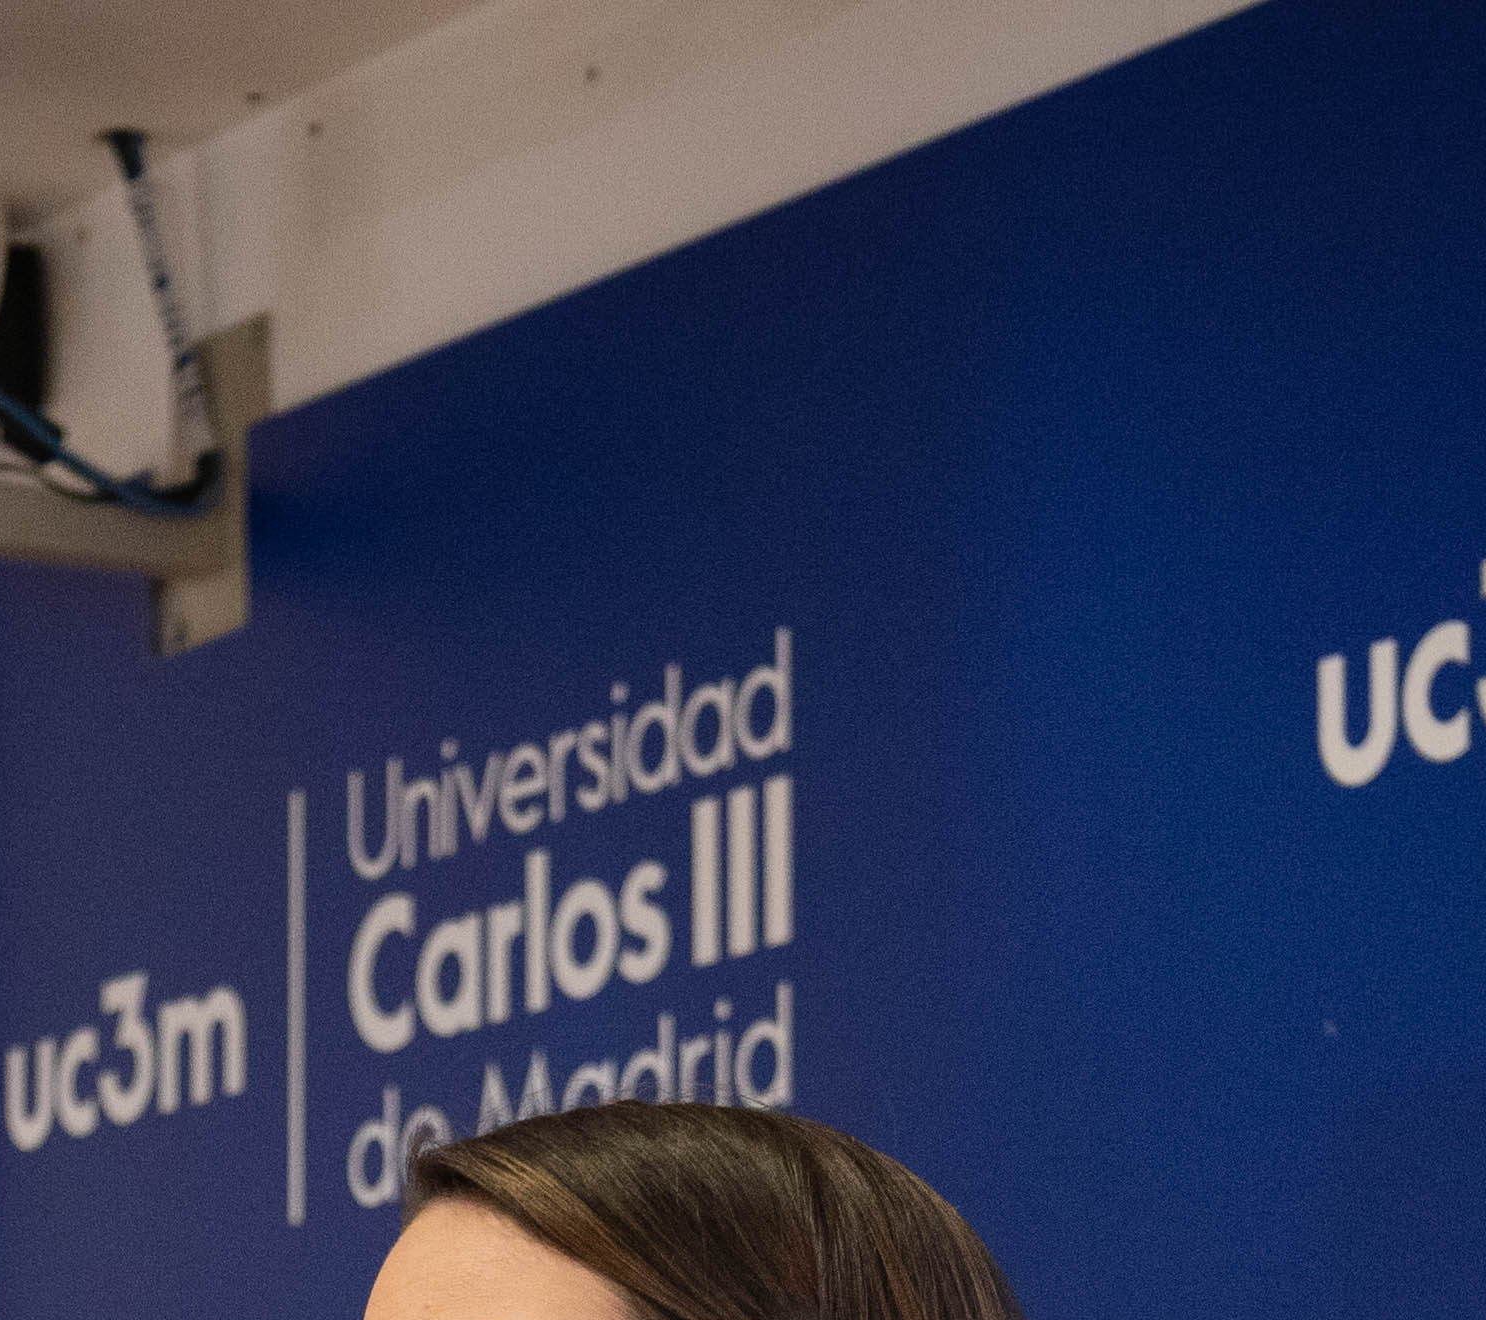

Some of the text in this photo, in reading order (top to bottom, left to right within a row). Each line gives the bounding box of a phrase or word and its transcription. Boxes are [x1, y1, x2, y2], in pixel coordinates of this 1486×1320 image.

[346, 626, 794, 880] Universidad
[347, 774, 795, 1054] Carlos III
[4, 972, 248, 1153] uc3m
